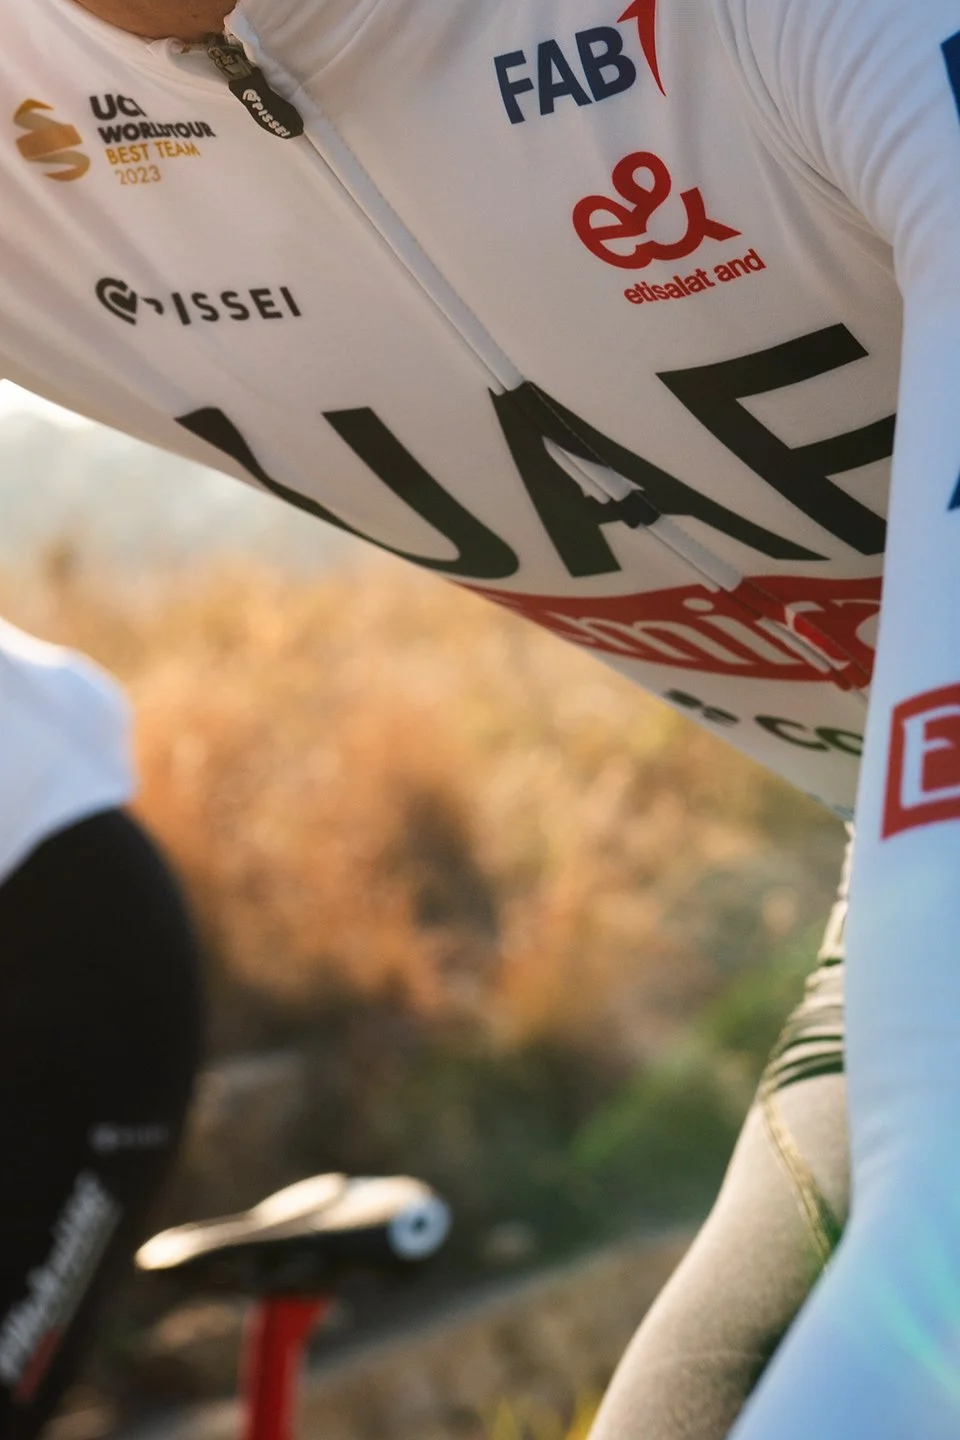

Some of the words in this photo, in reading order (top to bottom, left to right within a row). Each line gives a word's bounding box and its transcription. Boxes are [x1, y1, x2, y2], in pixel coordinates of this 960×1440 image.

[494, 25, 637, 125] FAB
[105, 143, 149, 165] BEST
[154, 141, 200, 159] TEAM
[115, 165, 161, 185] 2023
[624, 268, 715, 304] etisalat
[714, 248, 766, 283] and
[174, 322, 898, 579] UAE
